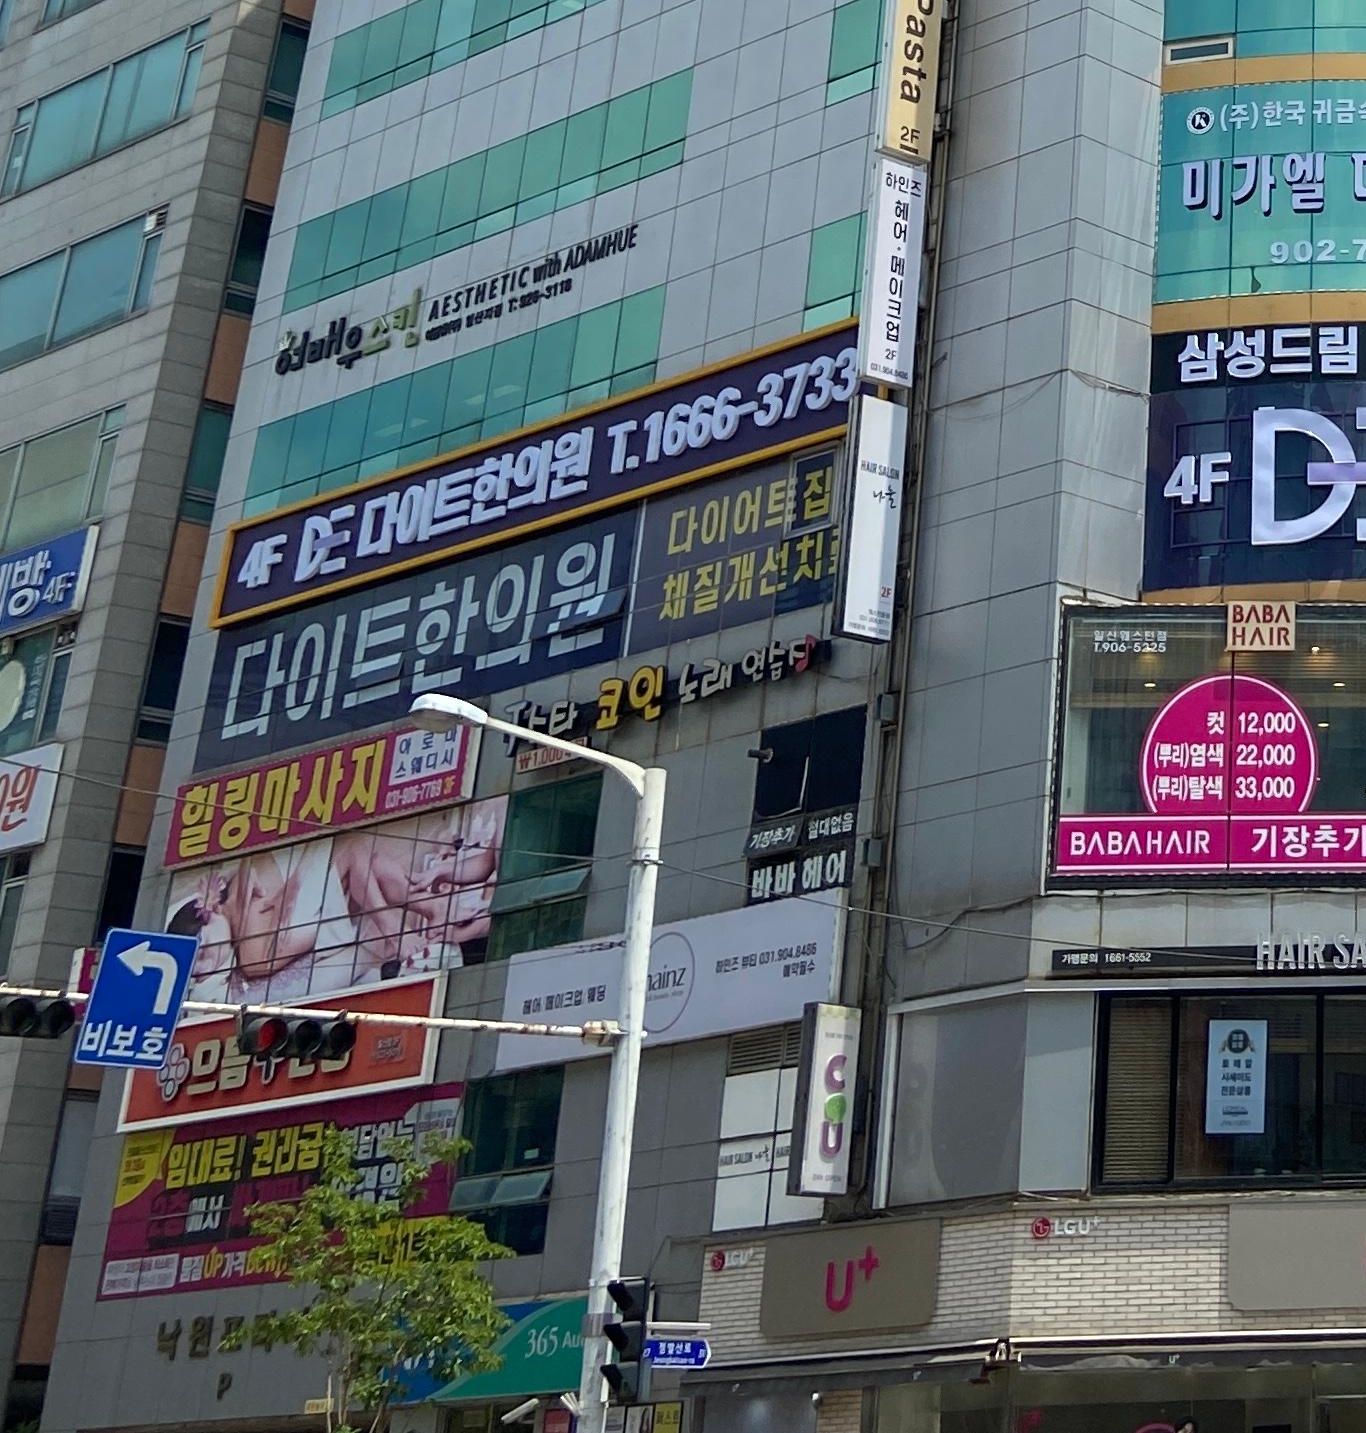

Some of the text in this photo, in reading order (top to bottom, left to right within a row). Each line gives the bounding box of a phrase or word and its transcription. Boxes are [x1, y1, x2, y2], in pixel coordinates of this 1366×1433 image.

[900, 125, 921, 145] 2F
[1182, 153, 1326, 219] 미가엘
[427, 266, 531, 322] AESTHETIC
[563, 224, 639, 273] ADAMHUE
[1177, 325, 1359, 383] 삼성드림
[238, 347, 859, 589] 4F 다이트한의원 T.1666-3733
[1163, 451, 1232, 505] 4F
[42, 571, 76, 605] 4F
[1231, 604, 1291, 624] BABA
[219, 533, 617, 744] 다이트한의원
[1231, 627, 1291, 647] HAIR
[596, 658, 733, 732] 코인 노래
[1205, 711, 1296, 735] 컷 12,000
[1153, 743, 1296, 770] (뿌리)염색 22,000
[178, 738, 388, 858] 힐링마사지
[1151, 775, 1296, 801] (뿌리)탈색 33,000
[751, 849, 847, 899] 바바헤어
[1256, 930, 1328, 971] HAIR
[80, 1020, 166, 1061] 비보호
[166, 1136, 247, 1190] 임대료!
[525, 1325, 558, 1359] 365
